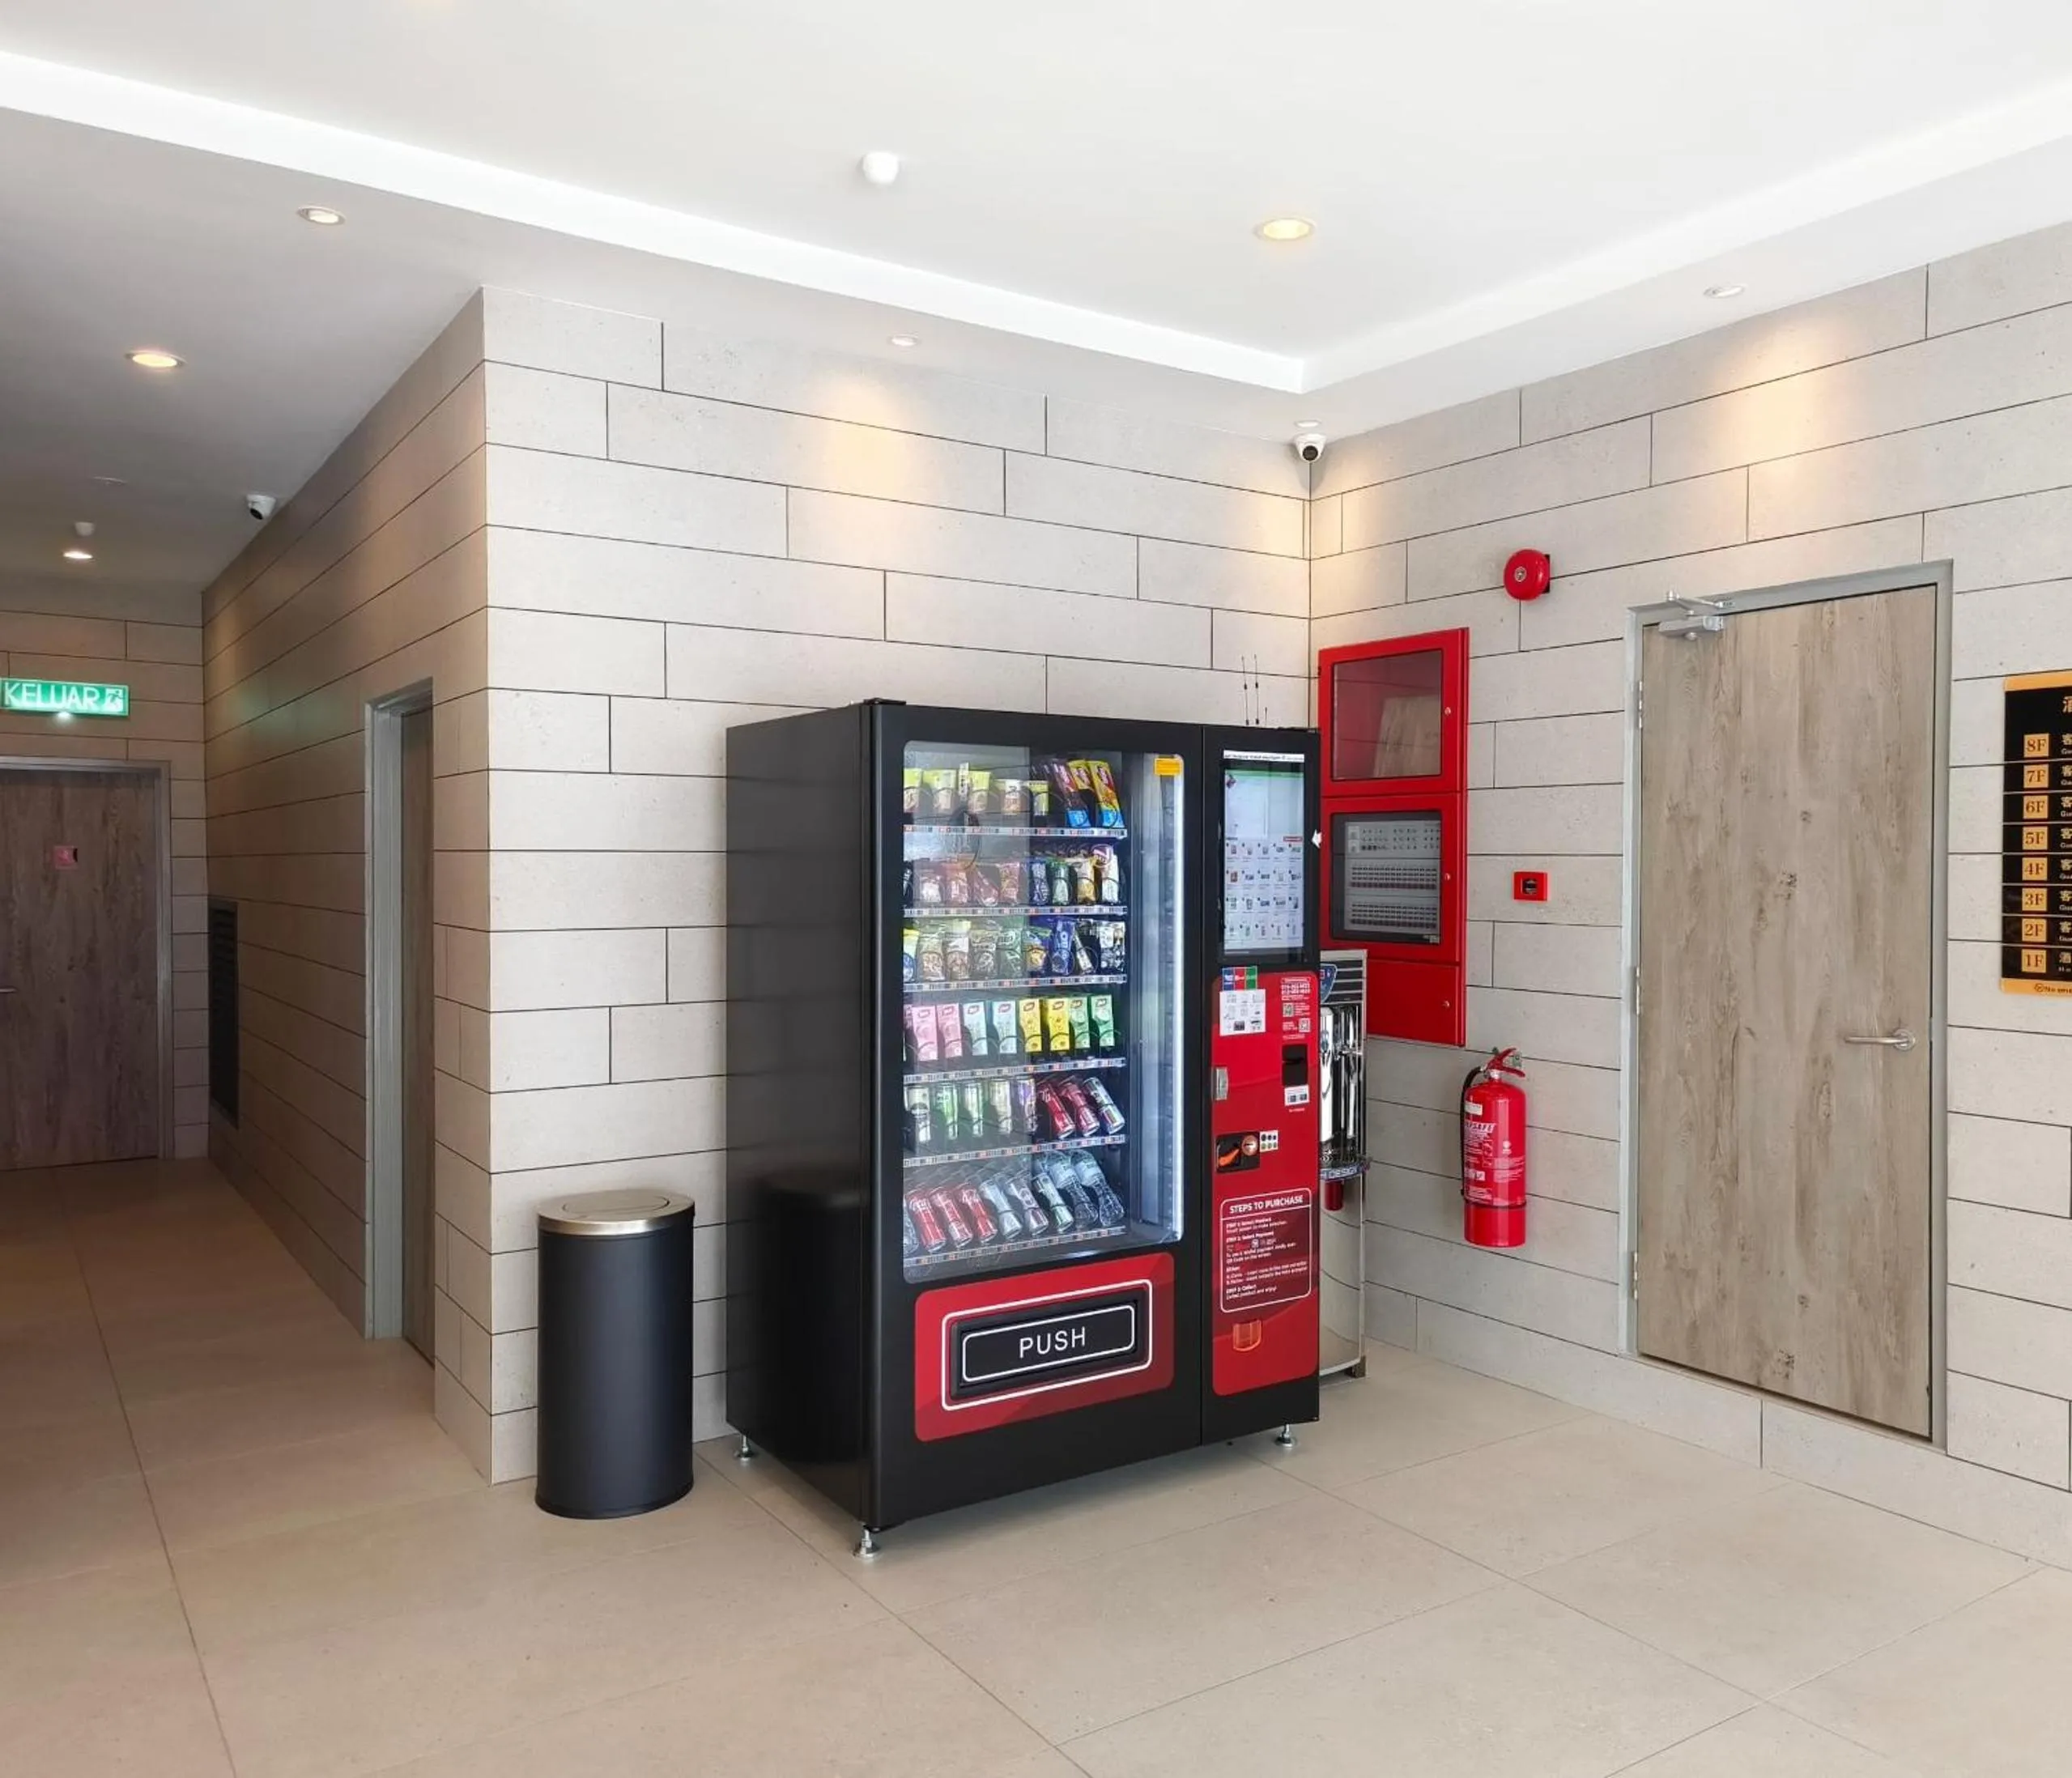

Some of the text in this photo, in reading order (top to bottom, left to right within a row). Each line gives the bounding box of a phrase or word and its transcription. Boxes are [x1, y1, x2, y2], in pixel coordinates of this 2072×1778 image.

[4, 682, 100, 710] KELUAR
[2027, 738, 2047, 752] 8F
[2027, 769, 2046, 783] 7F
[2026, 800, 2045, 814] 6F
[2025, 831, 2045, 844] 5F
[2024, 861, 2045, 875] 4F
[2025, 893, 2044, 906] 3F
[2025, 924, 2044, 937] 2F
[2026, 954, 2044, 968] 1F
[1230, 1194, 1304, 1214] STEPS TO PURCHASE
[1019, 1326, 1086, 1359] PUSH
